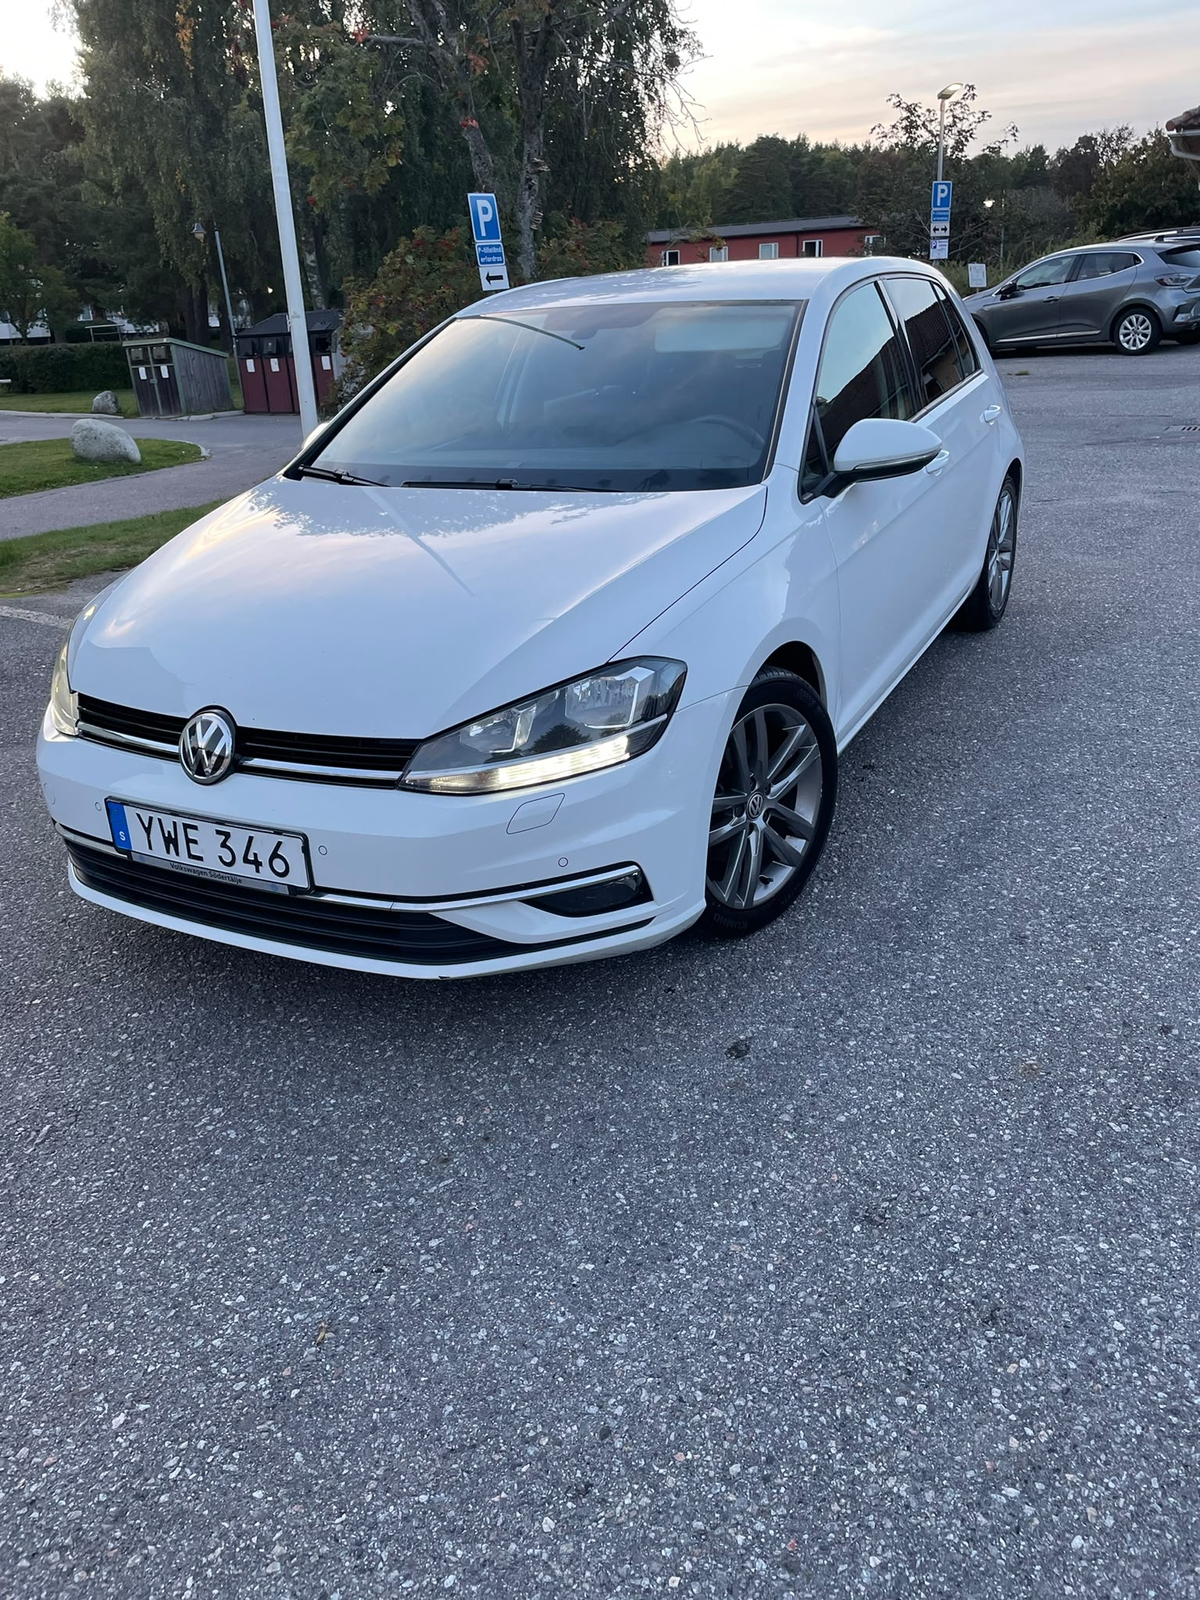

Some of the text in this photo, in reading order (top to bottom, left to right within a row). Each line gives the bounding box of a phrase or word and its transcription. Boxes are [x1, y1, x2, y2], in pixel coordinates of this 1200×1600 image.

[936, 184, 948, 206] P
[476, 199, 493, 236] P
[119, 830, 126, 841] S
[135, 812, 290, 878] YWE 346
[169, 862, 243, 884] Volkswagen Södertälje
[713, 912, 748, 930] KUMHO
